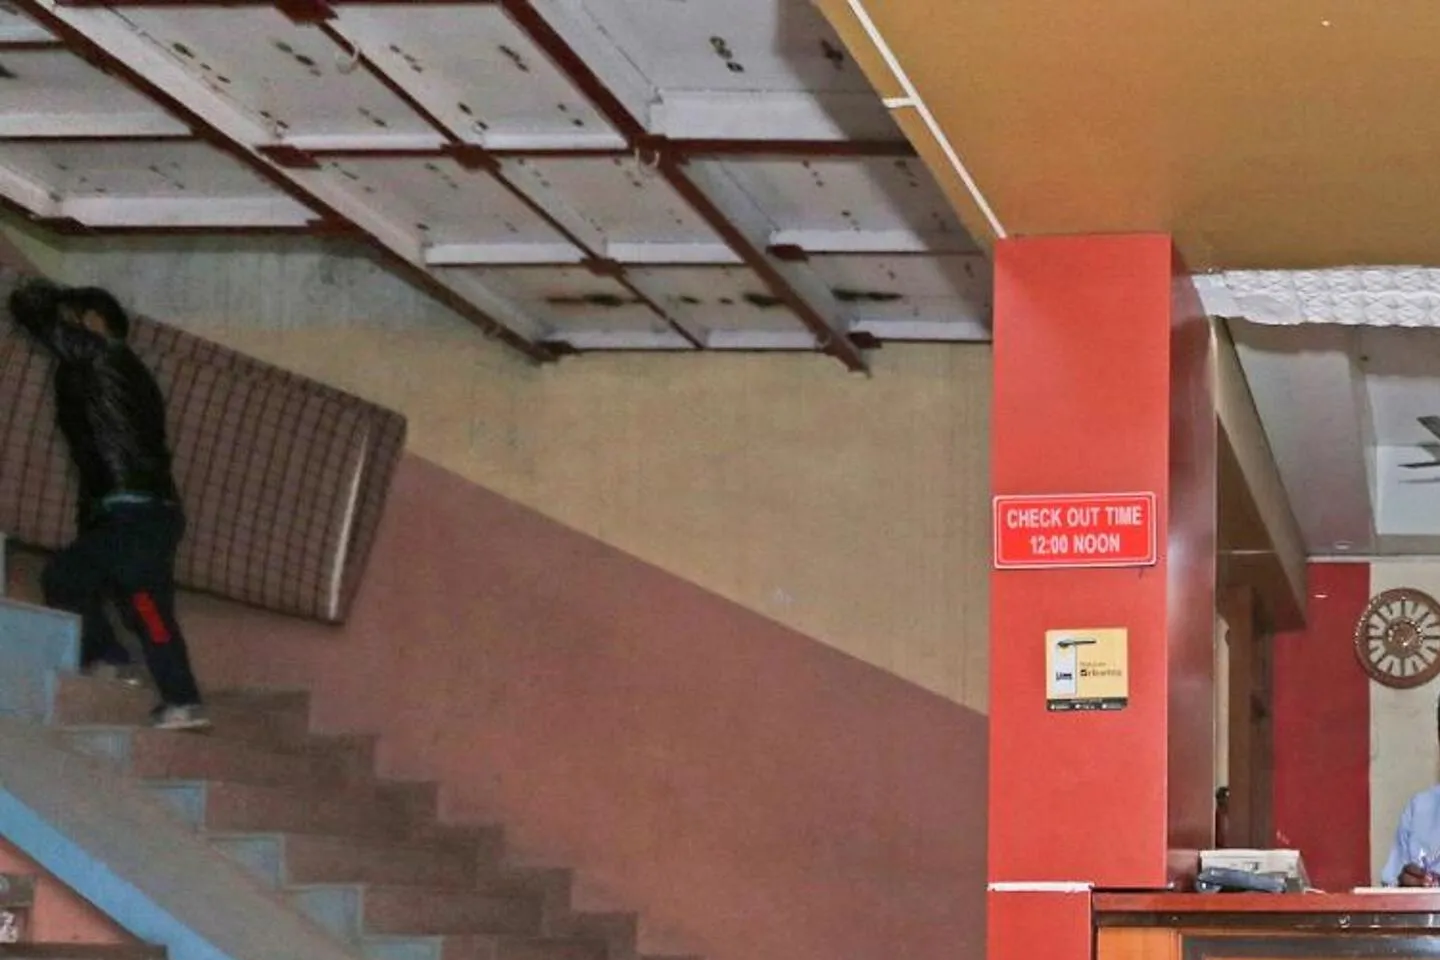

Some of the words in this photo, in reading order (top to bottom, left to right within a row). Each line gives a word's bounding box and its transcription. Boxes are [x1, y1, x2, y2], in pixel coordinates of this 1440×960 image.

[1006, 508, 1063, 529] CHECK
[1066, 507, 1100, 528] OUT
[1105, 505, 1143, 526] TIME
[1030, 535, 1069, 555] 12:00
[1073, 533, 1121, 554] NOON
